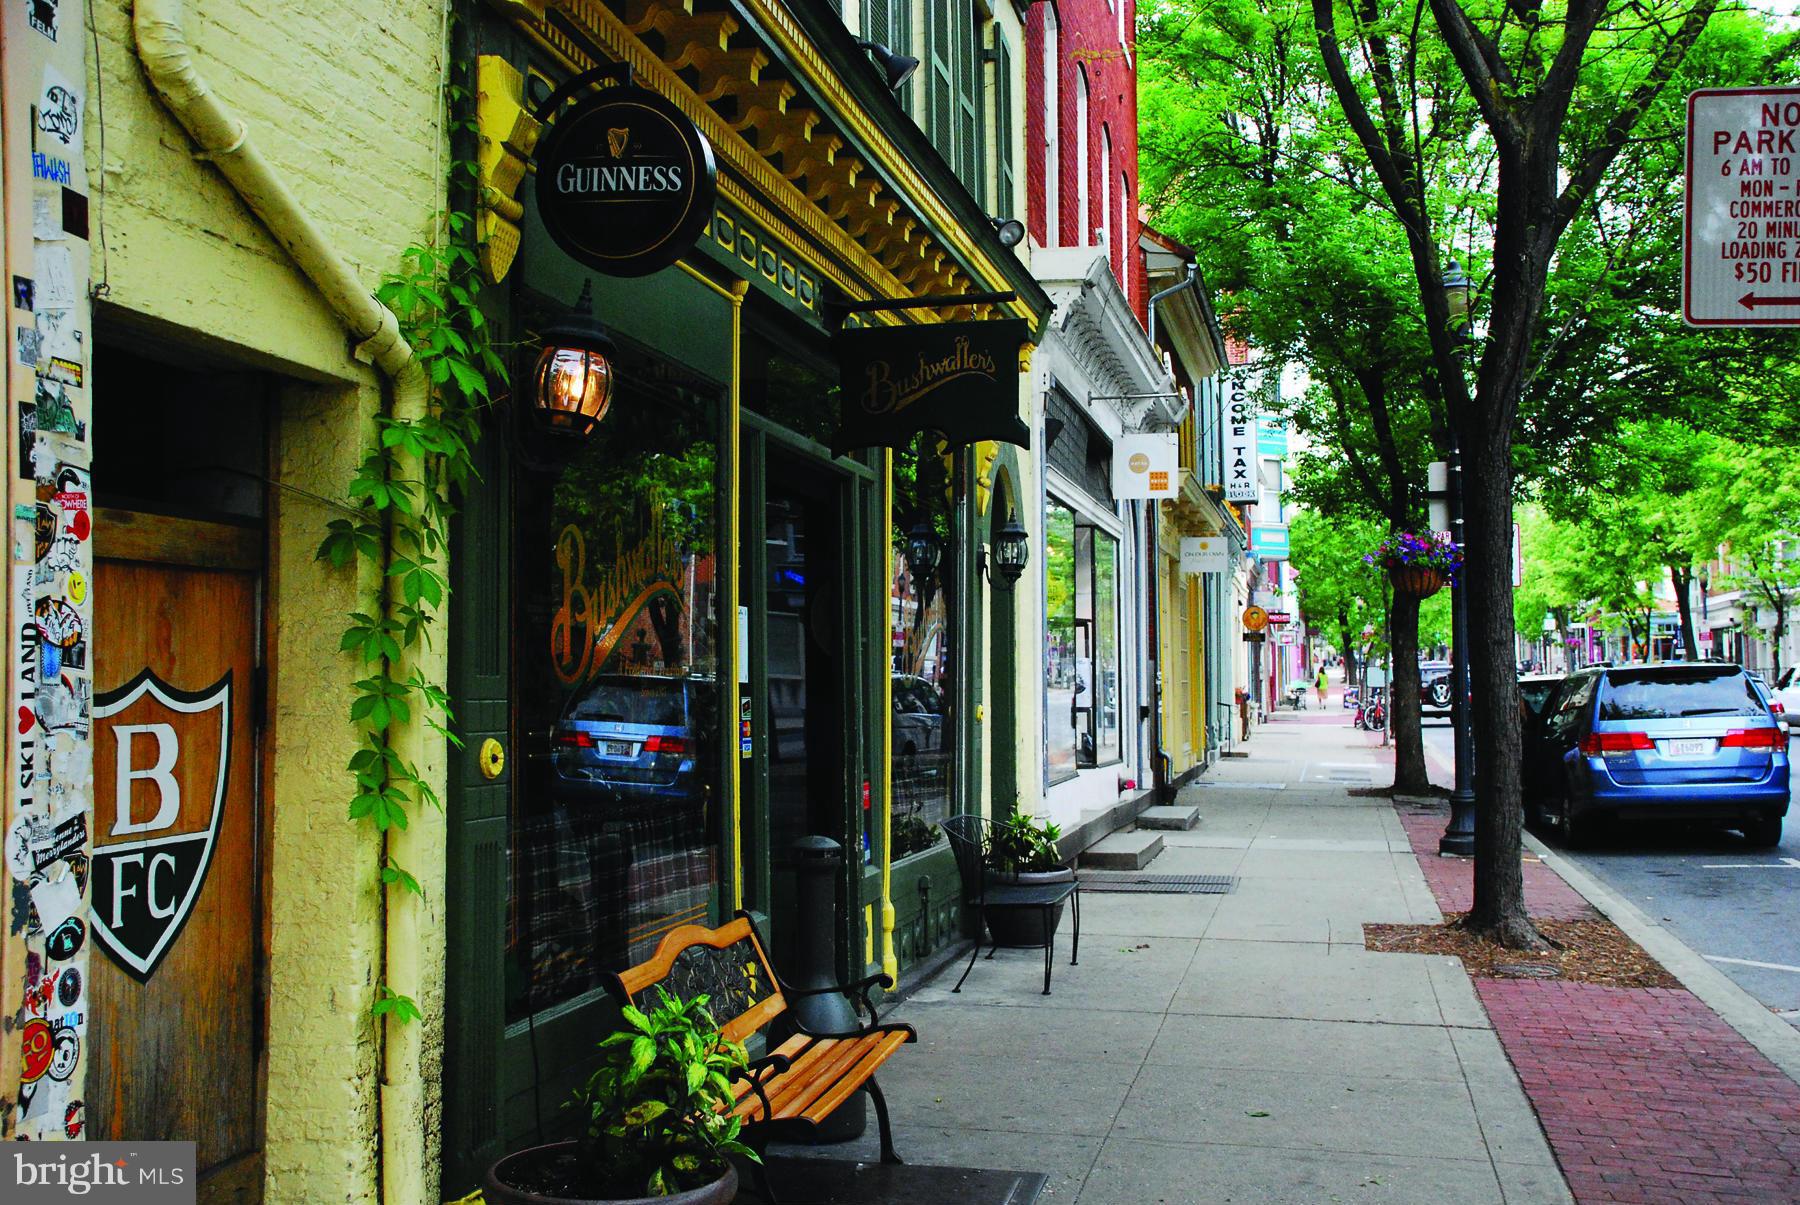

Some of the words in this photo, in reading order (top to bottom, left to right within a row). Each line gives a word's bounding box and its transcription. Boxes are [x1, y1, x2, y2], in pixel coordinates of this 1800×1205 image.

[1761, 102, 1800, 127] NO
[1714, 130, 1796, 155] PARK
[557, 163, 682, 194] GUINNESS
[1721, 159, 1731, 176] 6
[1739, 159, 1762, 175] AM
[1771, 157, 1790, 175] TO
[1741, 180, 1773, 197] MON
[1738, 222, 1758, 239] 20
[1722, 241, 1787, 259] LOADING
[1734, 262, 1771, 284] $50
[1782, 261, 1800, 283] FI
[1231, 370, 1247, 436] NCOME
[1233, 446, 1246, 479] TAX
[21, 741, 34, 789] SKI
[111, 723, 180, 836] B
[111, 853, 175, 928] FC
